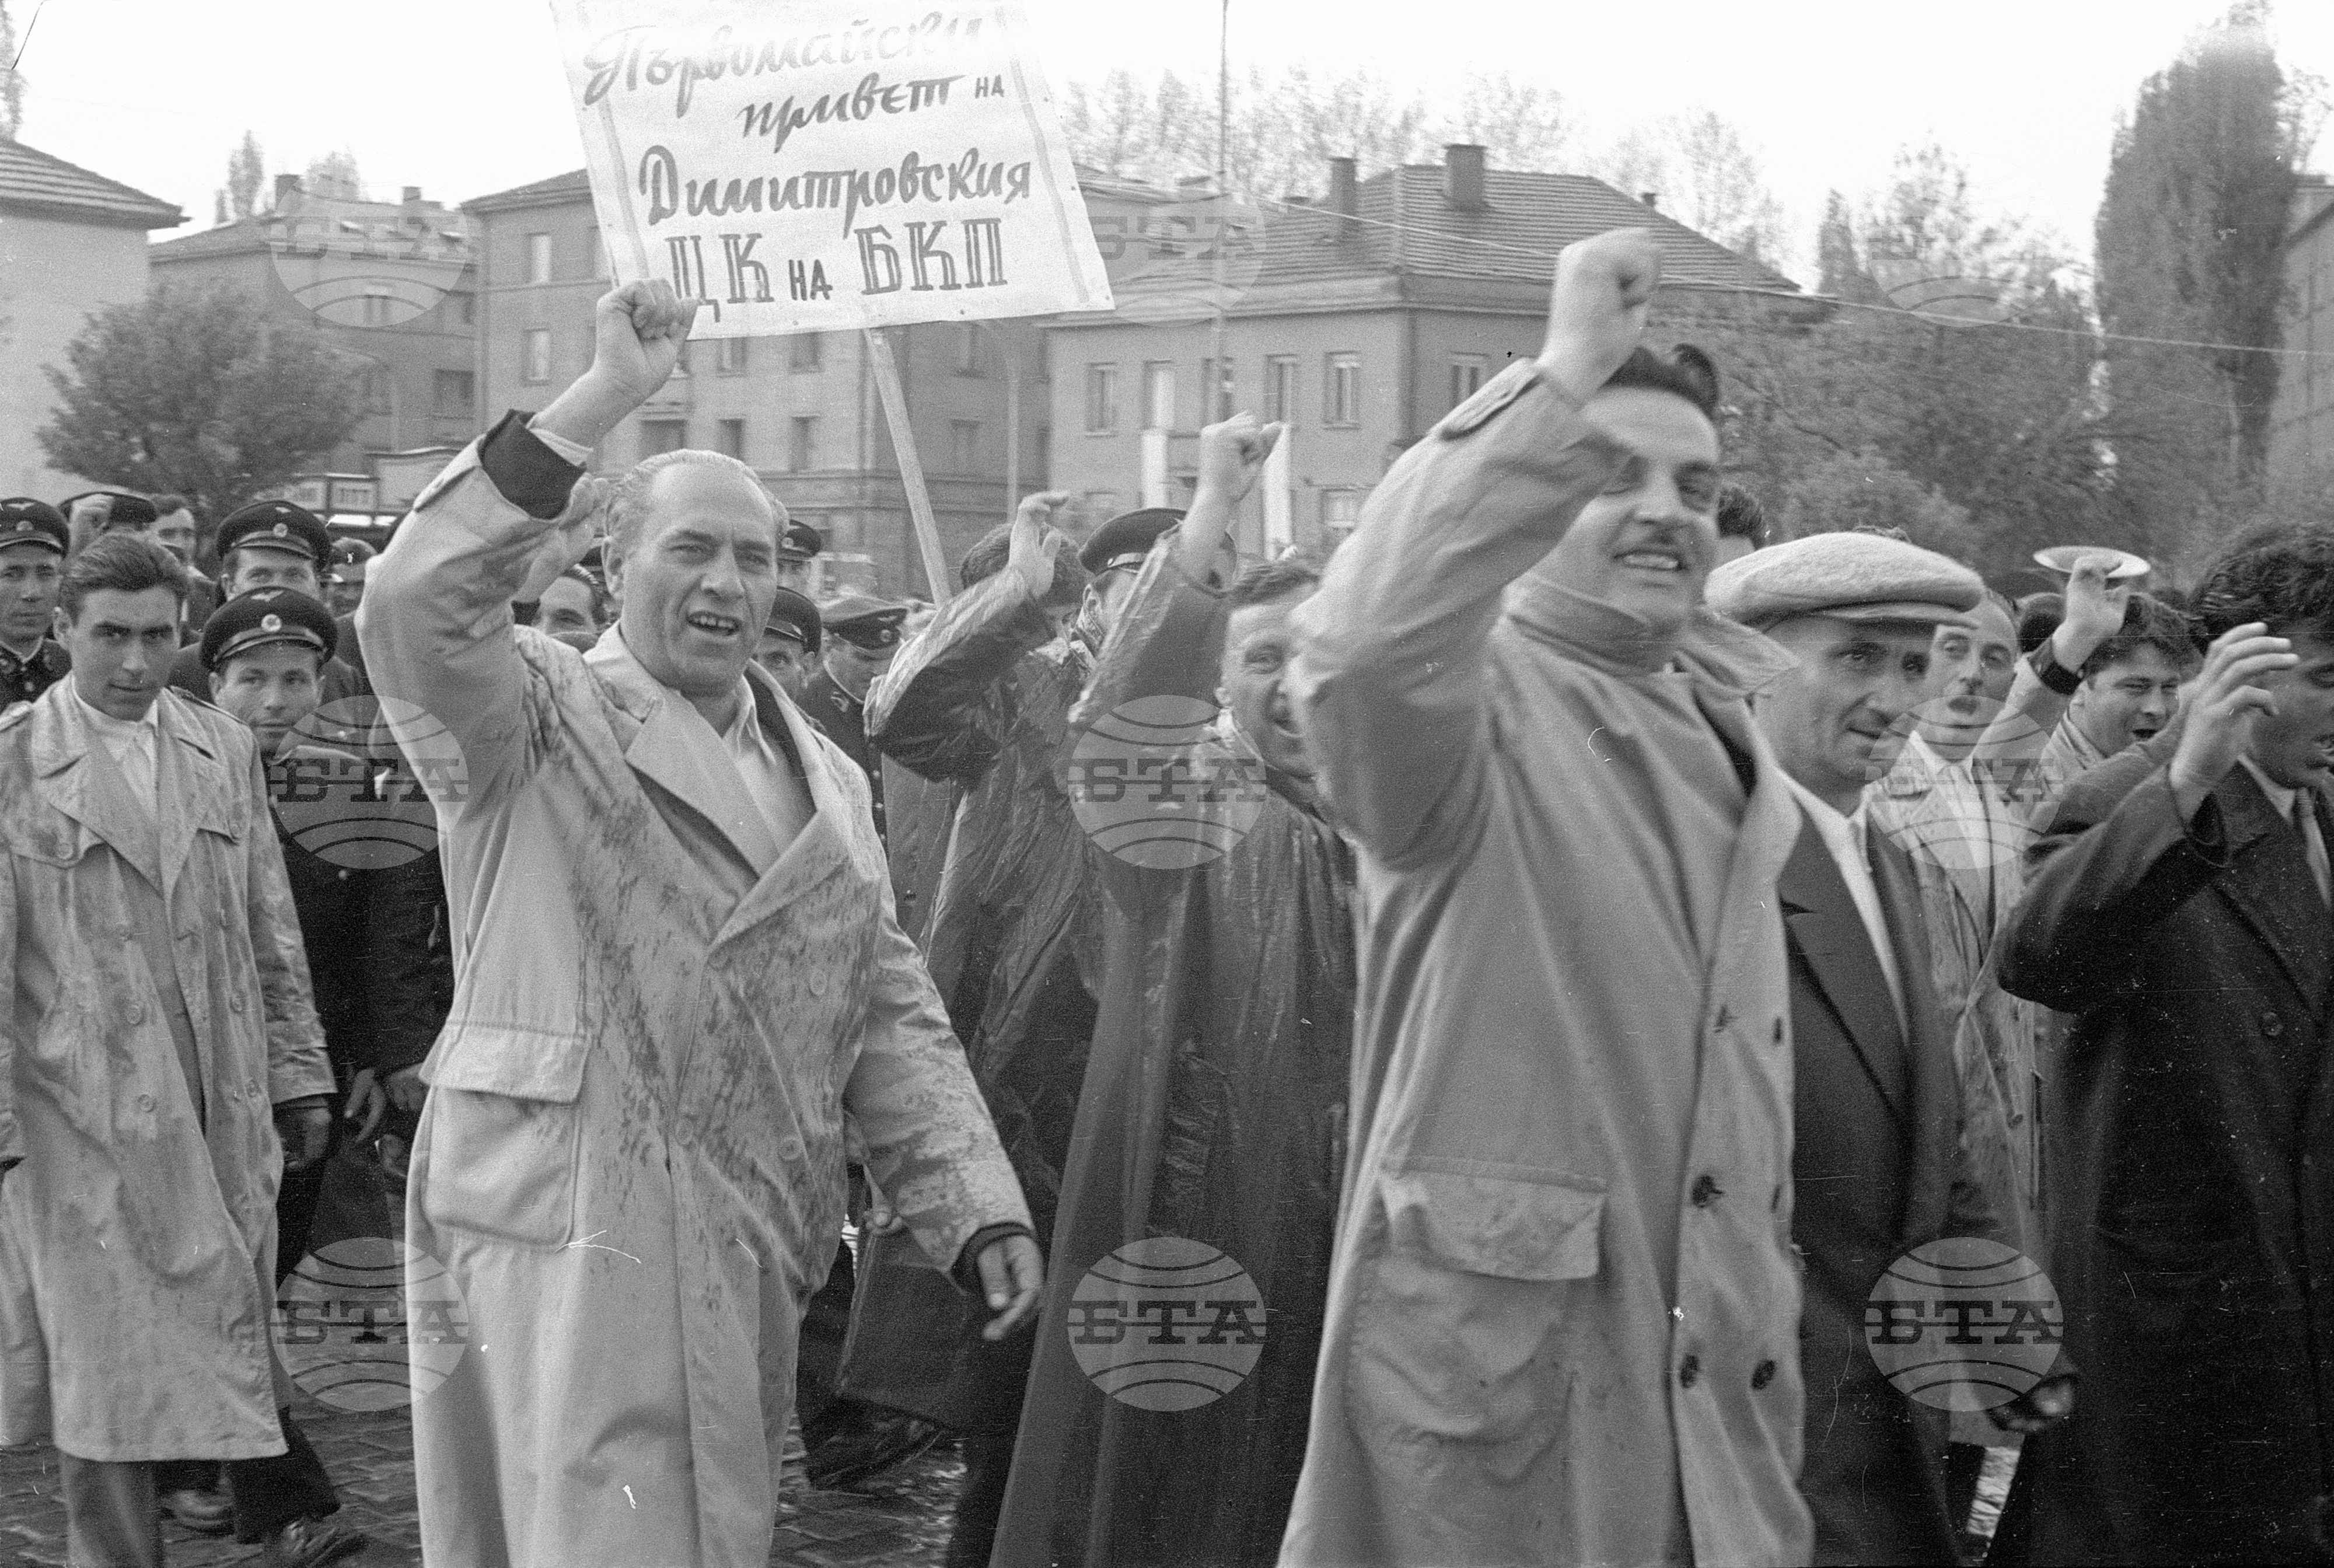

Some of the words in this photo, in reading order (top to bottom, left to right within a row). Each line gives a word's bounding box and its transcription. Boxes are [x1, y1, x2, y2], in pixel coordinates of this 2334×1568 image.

[638, 144, 1031, 239] Димитровския
[665, 232, 774, 323] ЦК
[854, 217, 1008, 295] БКП
